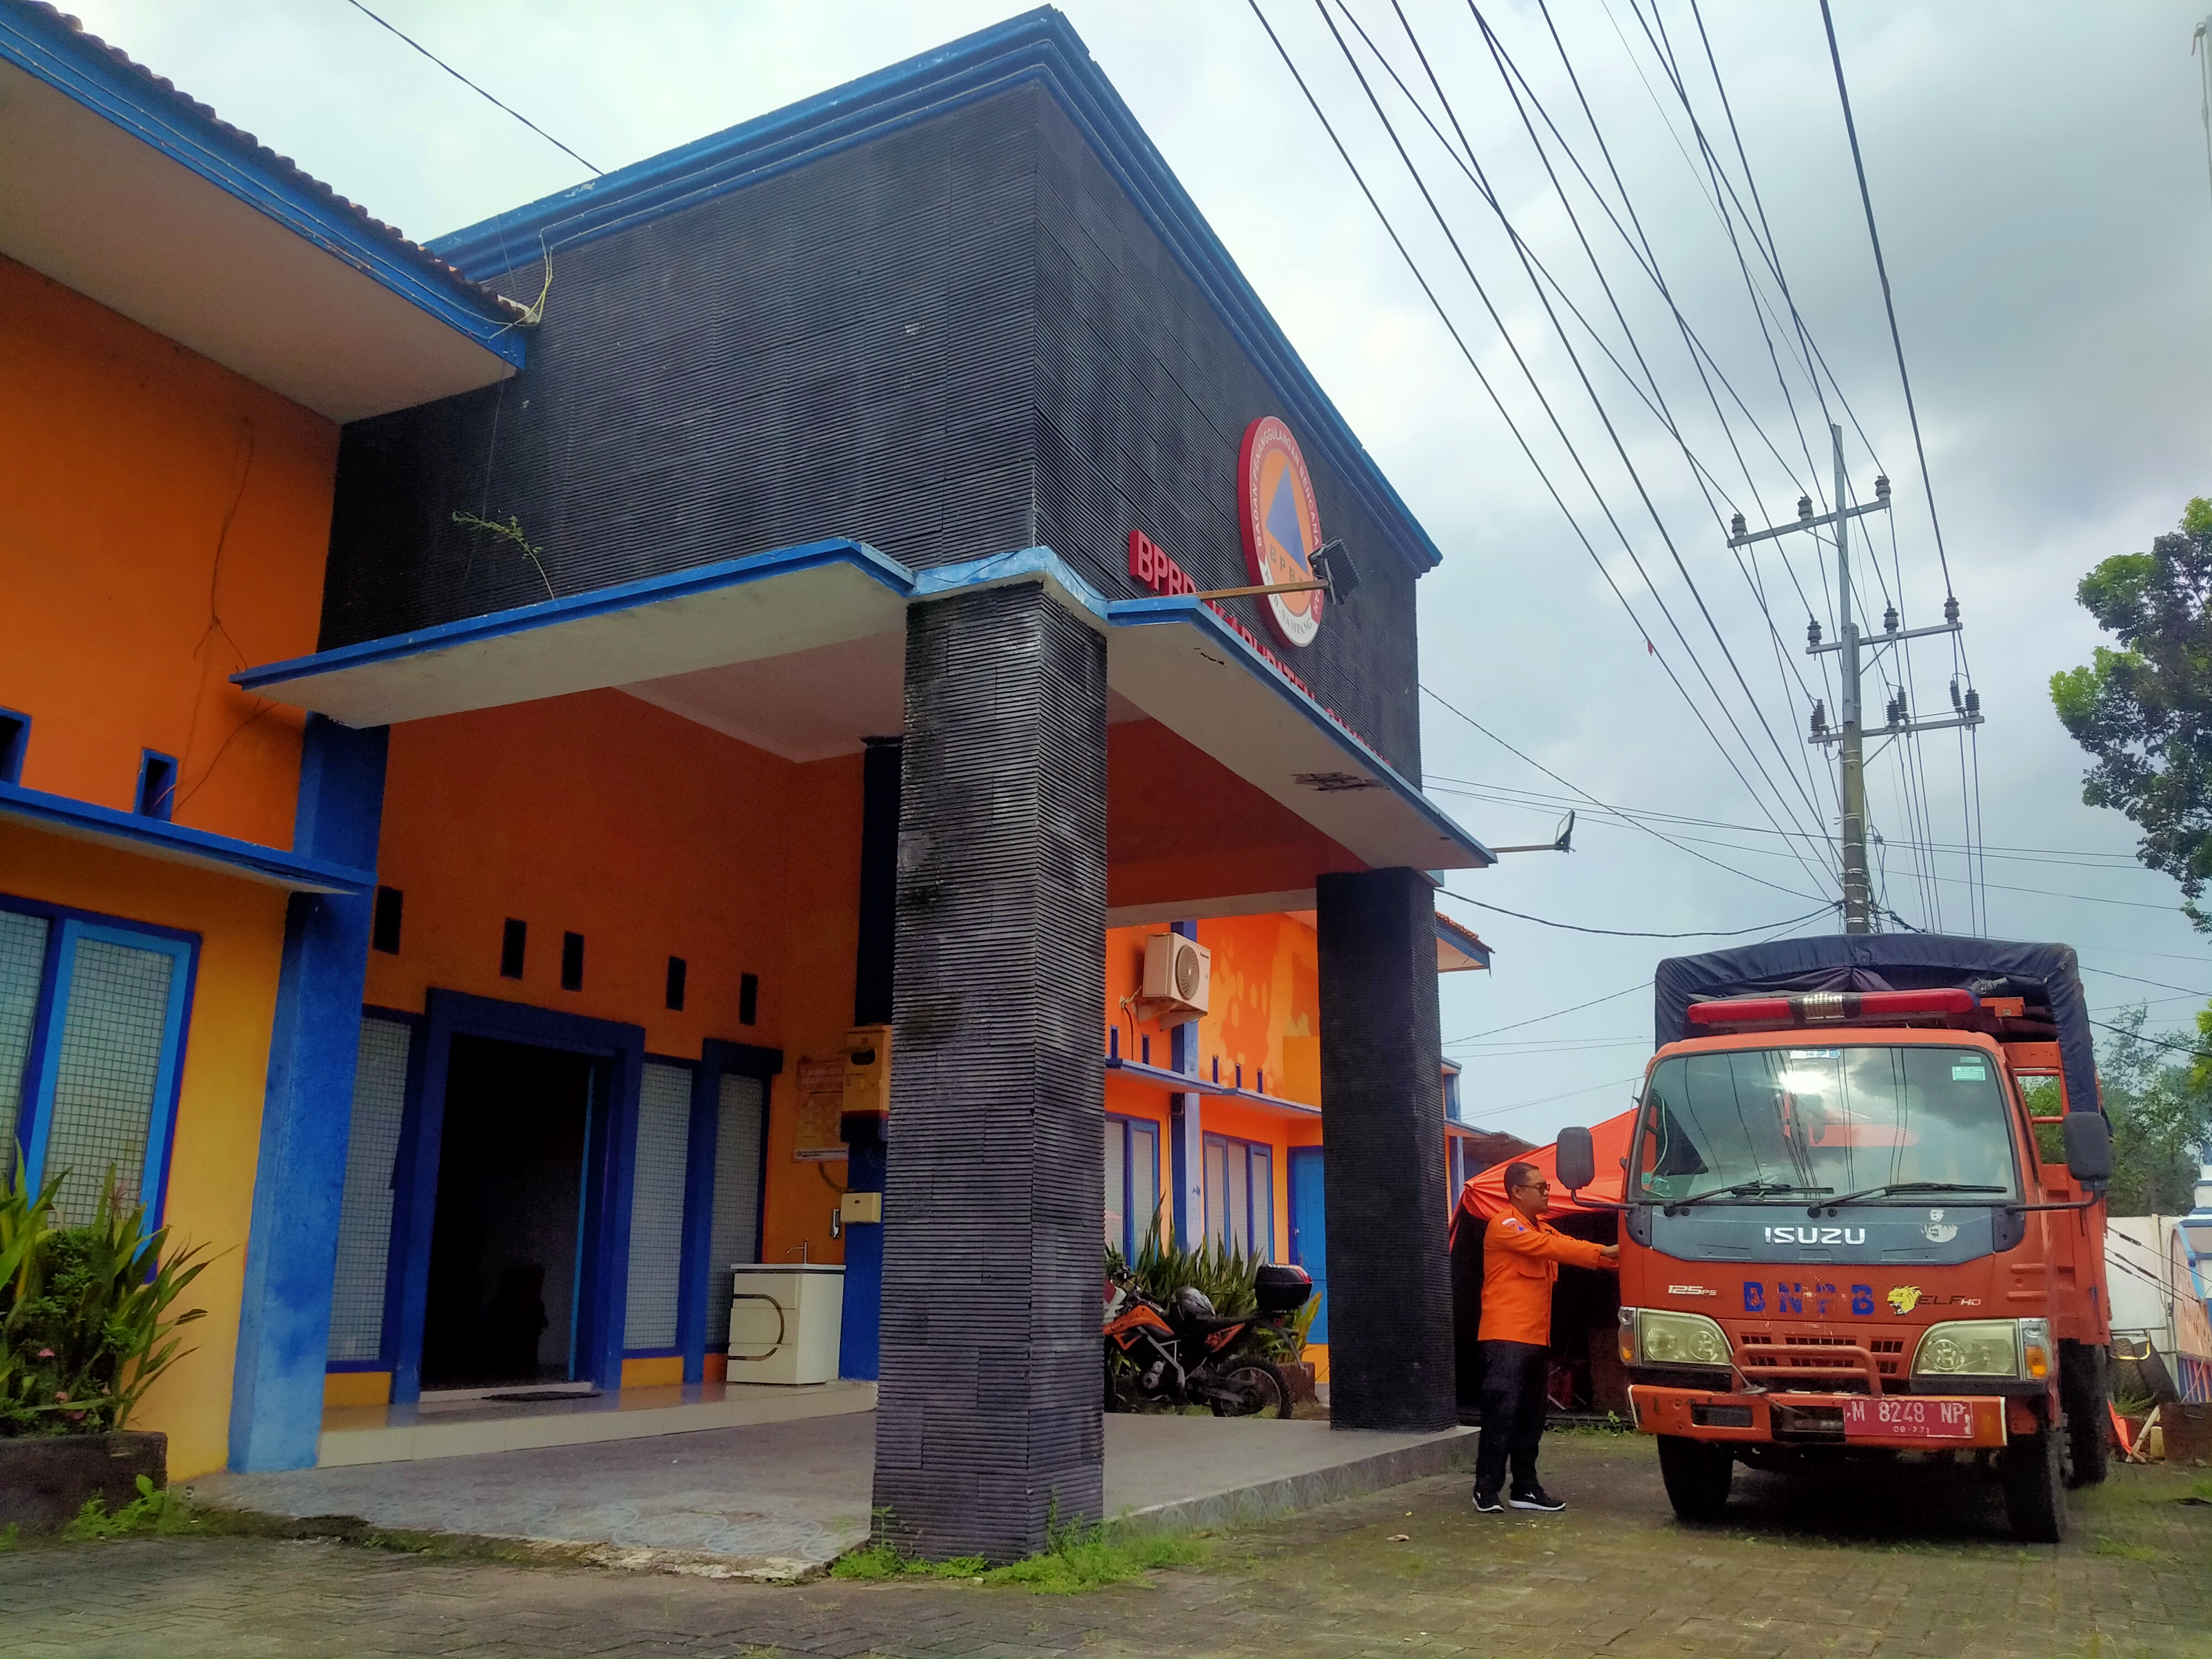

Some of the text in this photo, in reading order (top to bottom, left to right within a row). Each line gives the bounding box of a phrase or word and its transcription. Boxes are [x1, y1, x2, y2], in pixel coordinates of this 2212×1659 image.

[1252, 427, 1319, 547] BADAN PENANGGULANGAN BENCANA
[1270, 544, 1305, 596] BPB
[1281, 611, 1312, 634] SAMPANG
[1764, 1227, 1866, 1245] ISUZU
[1851, 1401, 1964, 1424] M 8248 NP
